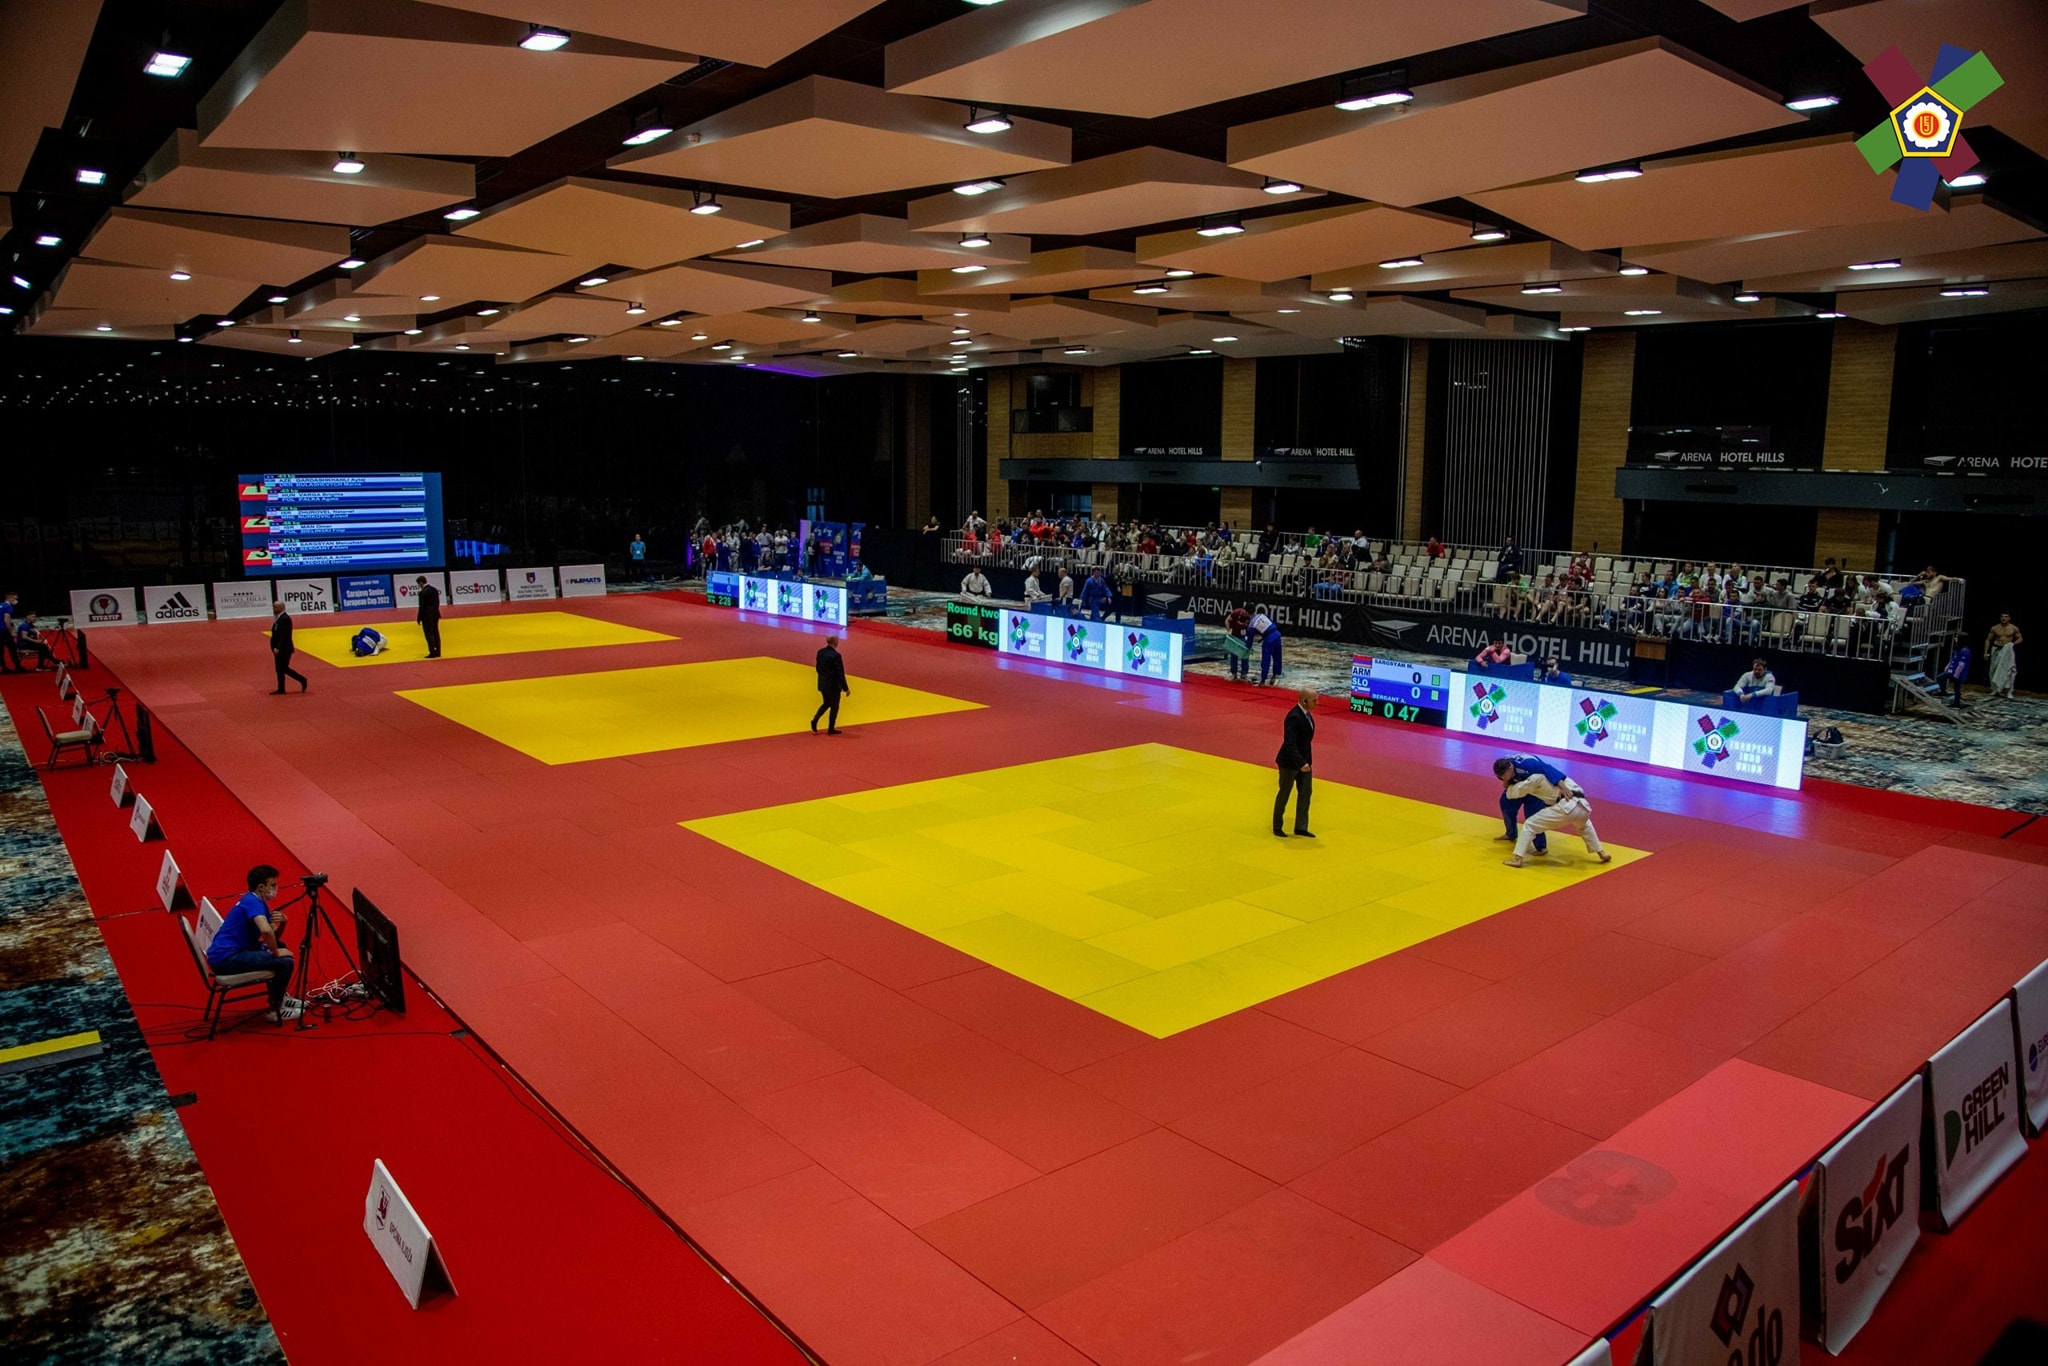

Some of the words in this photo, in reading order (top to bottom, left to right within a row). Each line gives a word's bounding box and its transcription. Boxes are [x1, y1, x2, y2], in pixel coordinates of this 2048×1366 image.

[1290, 448, 1312, 456] ARENA
[1316, 448, 1338, 456] HOTEL
[1339, 448, 1355, 456] HILL
[1680, 452, 1712, 462] ARENA
[1720, 452, 1753, 462] HOTEL
[1756, 452, 1785, 462] HILLS
[1957, 456, 2000, 468] ARENA
[456, 582, 496, 594] essimo
[284, 592, 314, 602] IPPON
[300, 601, 327, 611] GEAR
[947, 602, 978, 616] Round
[981, 607, 1000, 619] two
[155, 608, 200, 619] adidas
[1187, 596, 1233, 616] ARENA
[1298, 607, 1343, 632] HILLS
[948, 622, 973, 638] -66
[978, 626, 999, 646] kg
[1426, 624, 1489, 648] ARENA
[1503, 632, 1571, 661] HOTEL
[1374, 659, 1406, 668] SARGSYAN
[1352, 667, 1371, 676] ARM
[1412, 672, 1422, 684] 0
[1352, 678, 1368, 687] SLO
[1410, 686, 1421, 699] 0
[1372, 694, 1399, 702] BERGANT
[1350, 704, 1362, 712] -73
[1363, 705, 1373, 715] kg
[1962, 1061, 2009, 1122] GREEN
[1964, 1096, 2005, 1155] HILL
